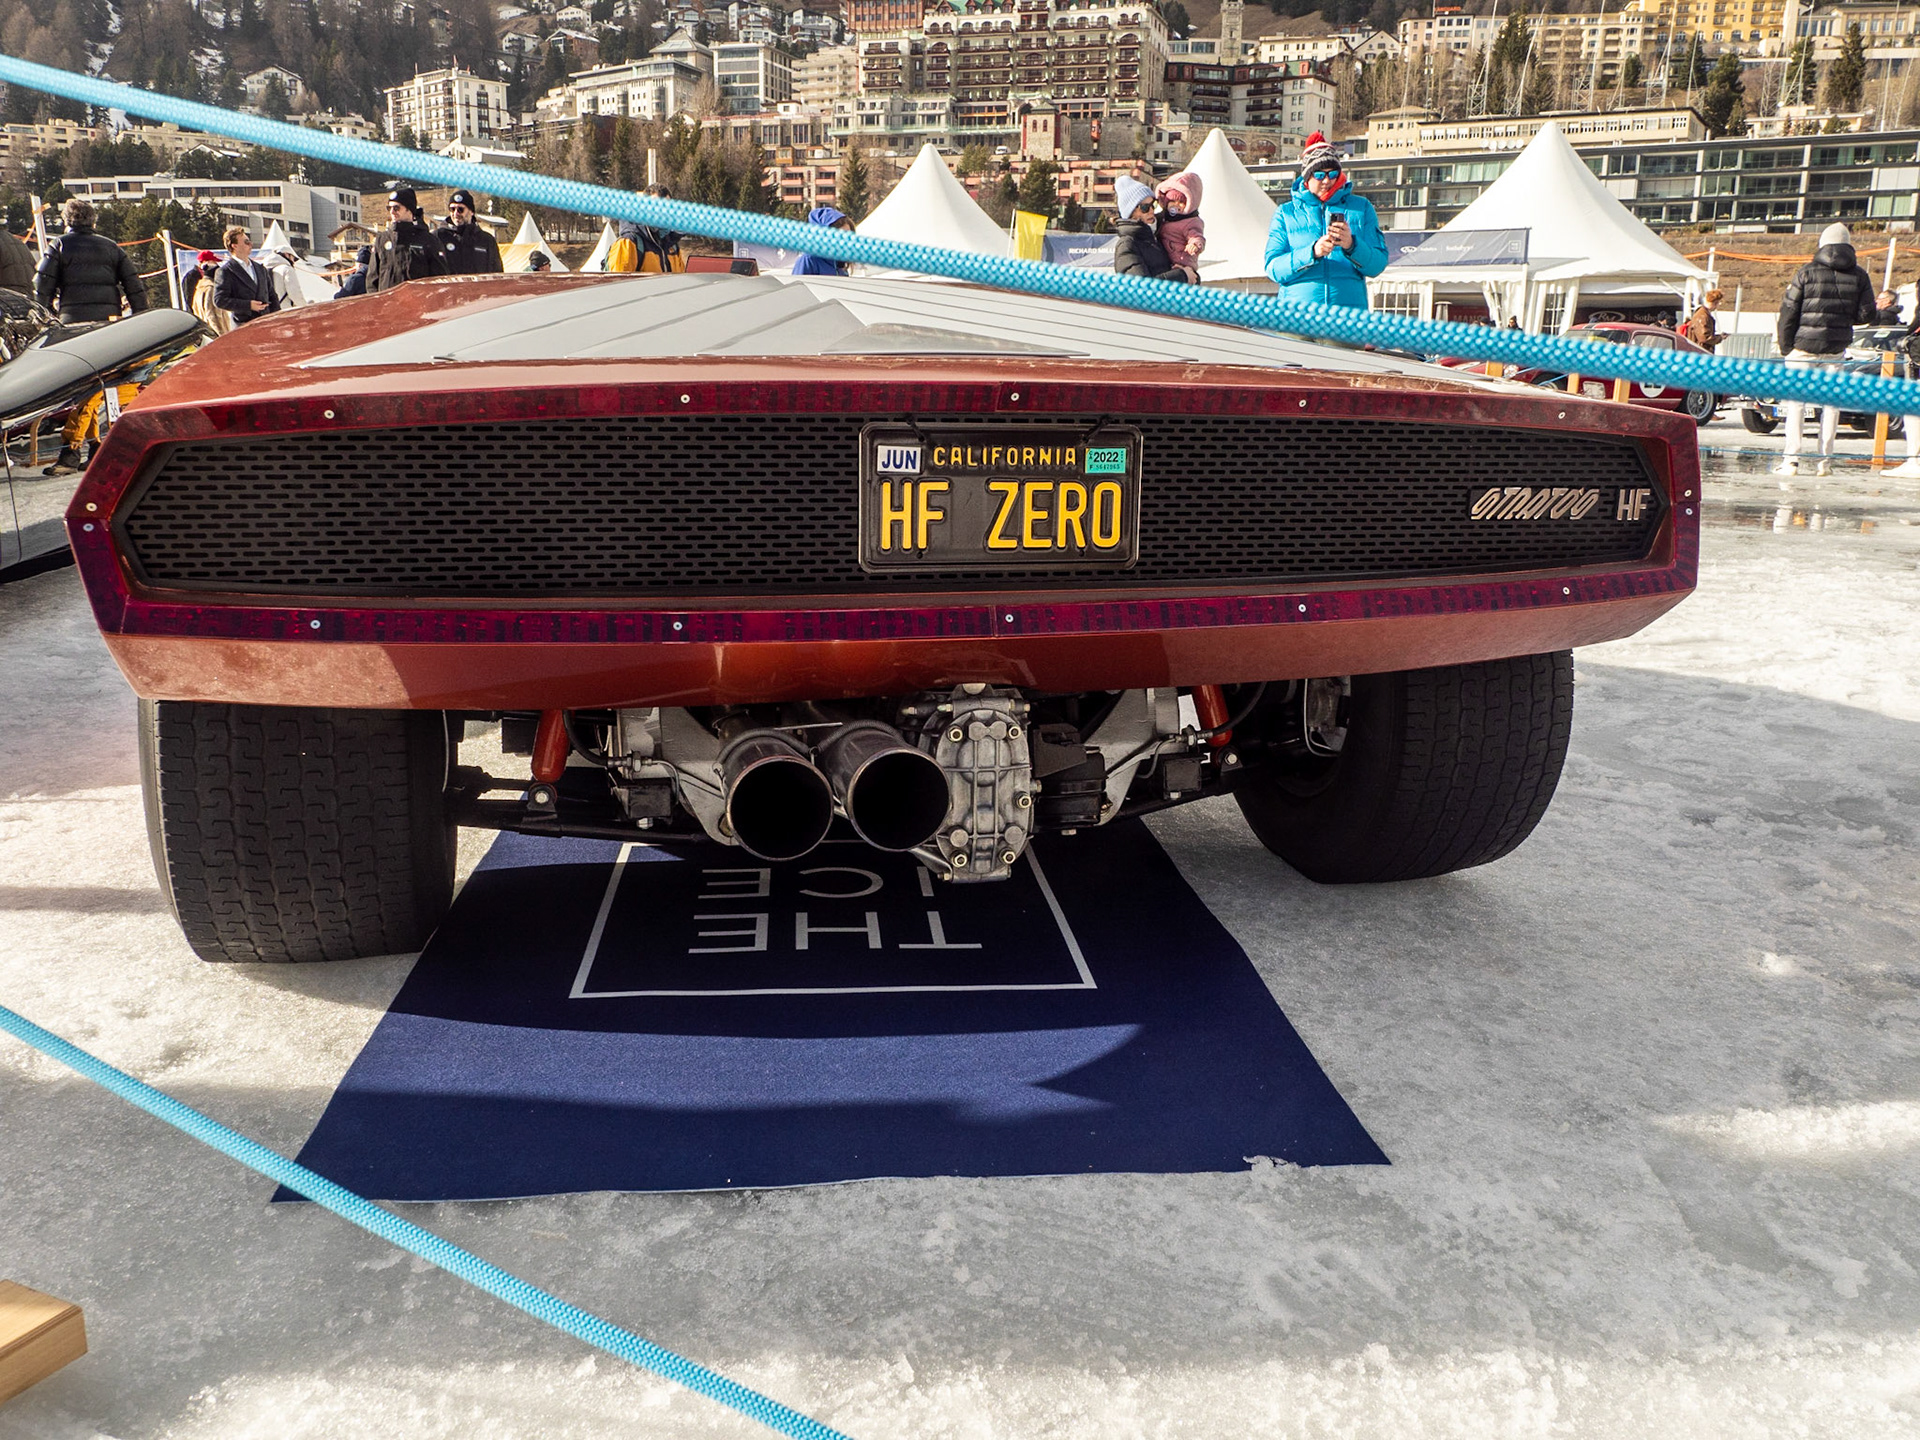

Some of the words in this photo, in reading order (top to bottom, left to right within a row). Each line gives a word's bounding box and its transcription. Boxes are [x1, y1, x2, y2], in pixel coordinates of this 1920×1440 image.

[881, 449, 918, 470] JUN
[933, 446, 1077, 467] CALIFORNIA
[1093, 451, 1119, 463] 2022
[880, 481, 950, 551] HF
[987, 481, 1122, 550] ZERO
[1616, 488, 1651, 521] HF
[688, 909, 983, 954] THE
